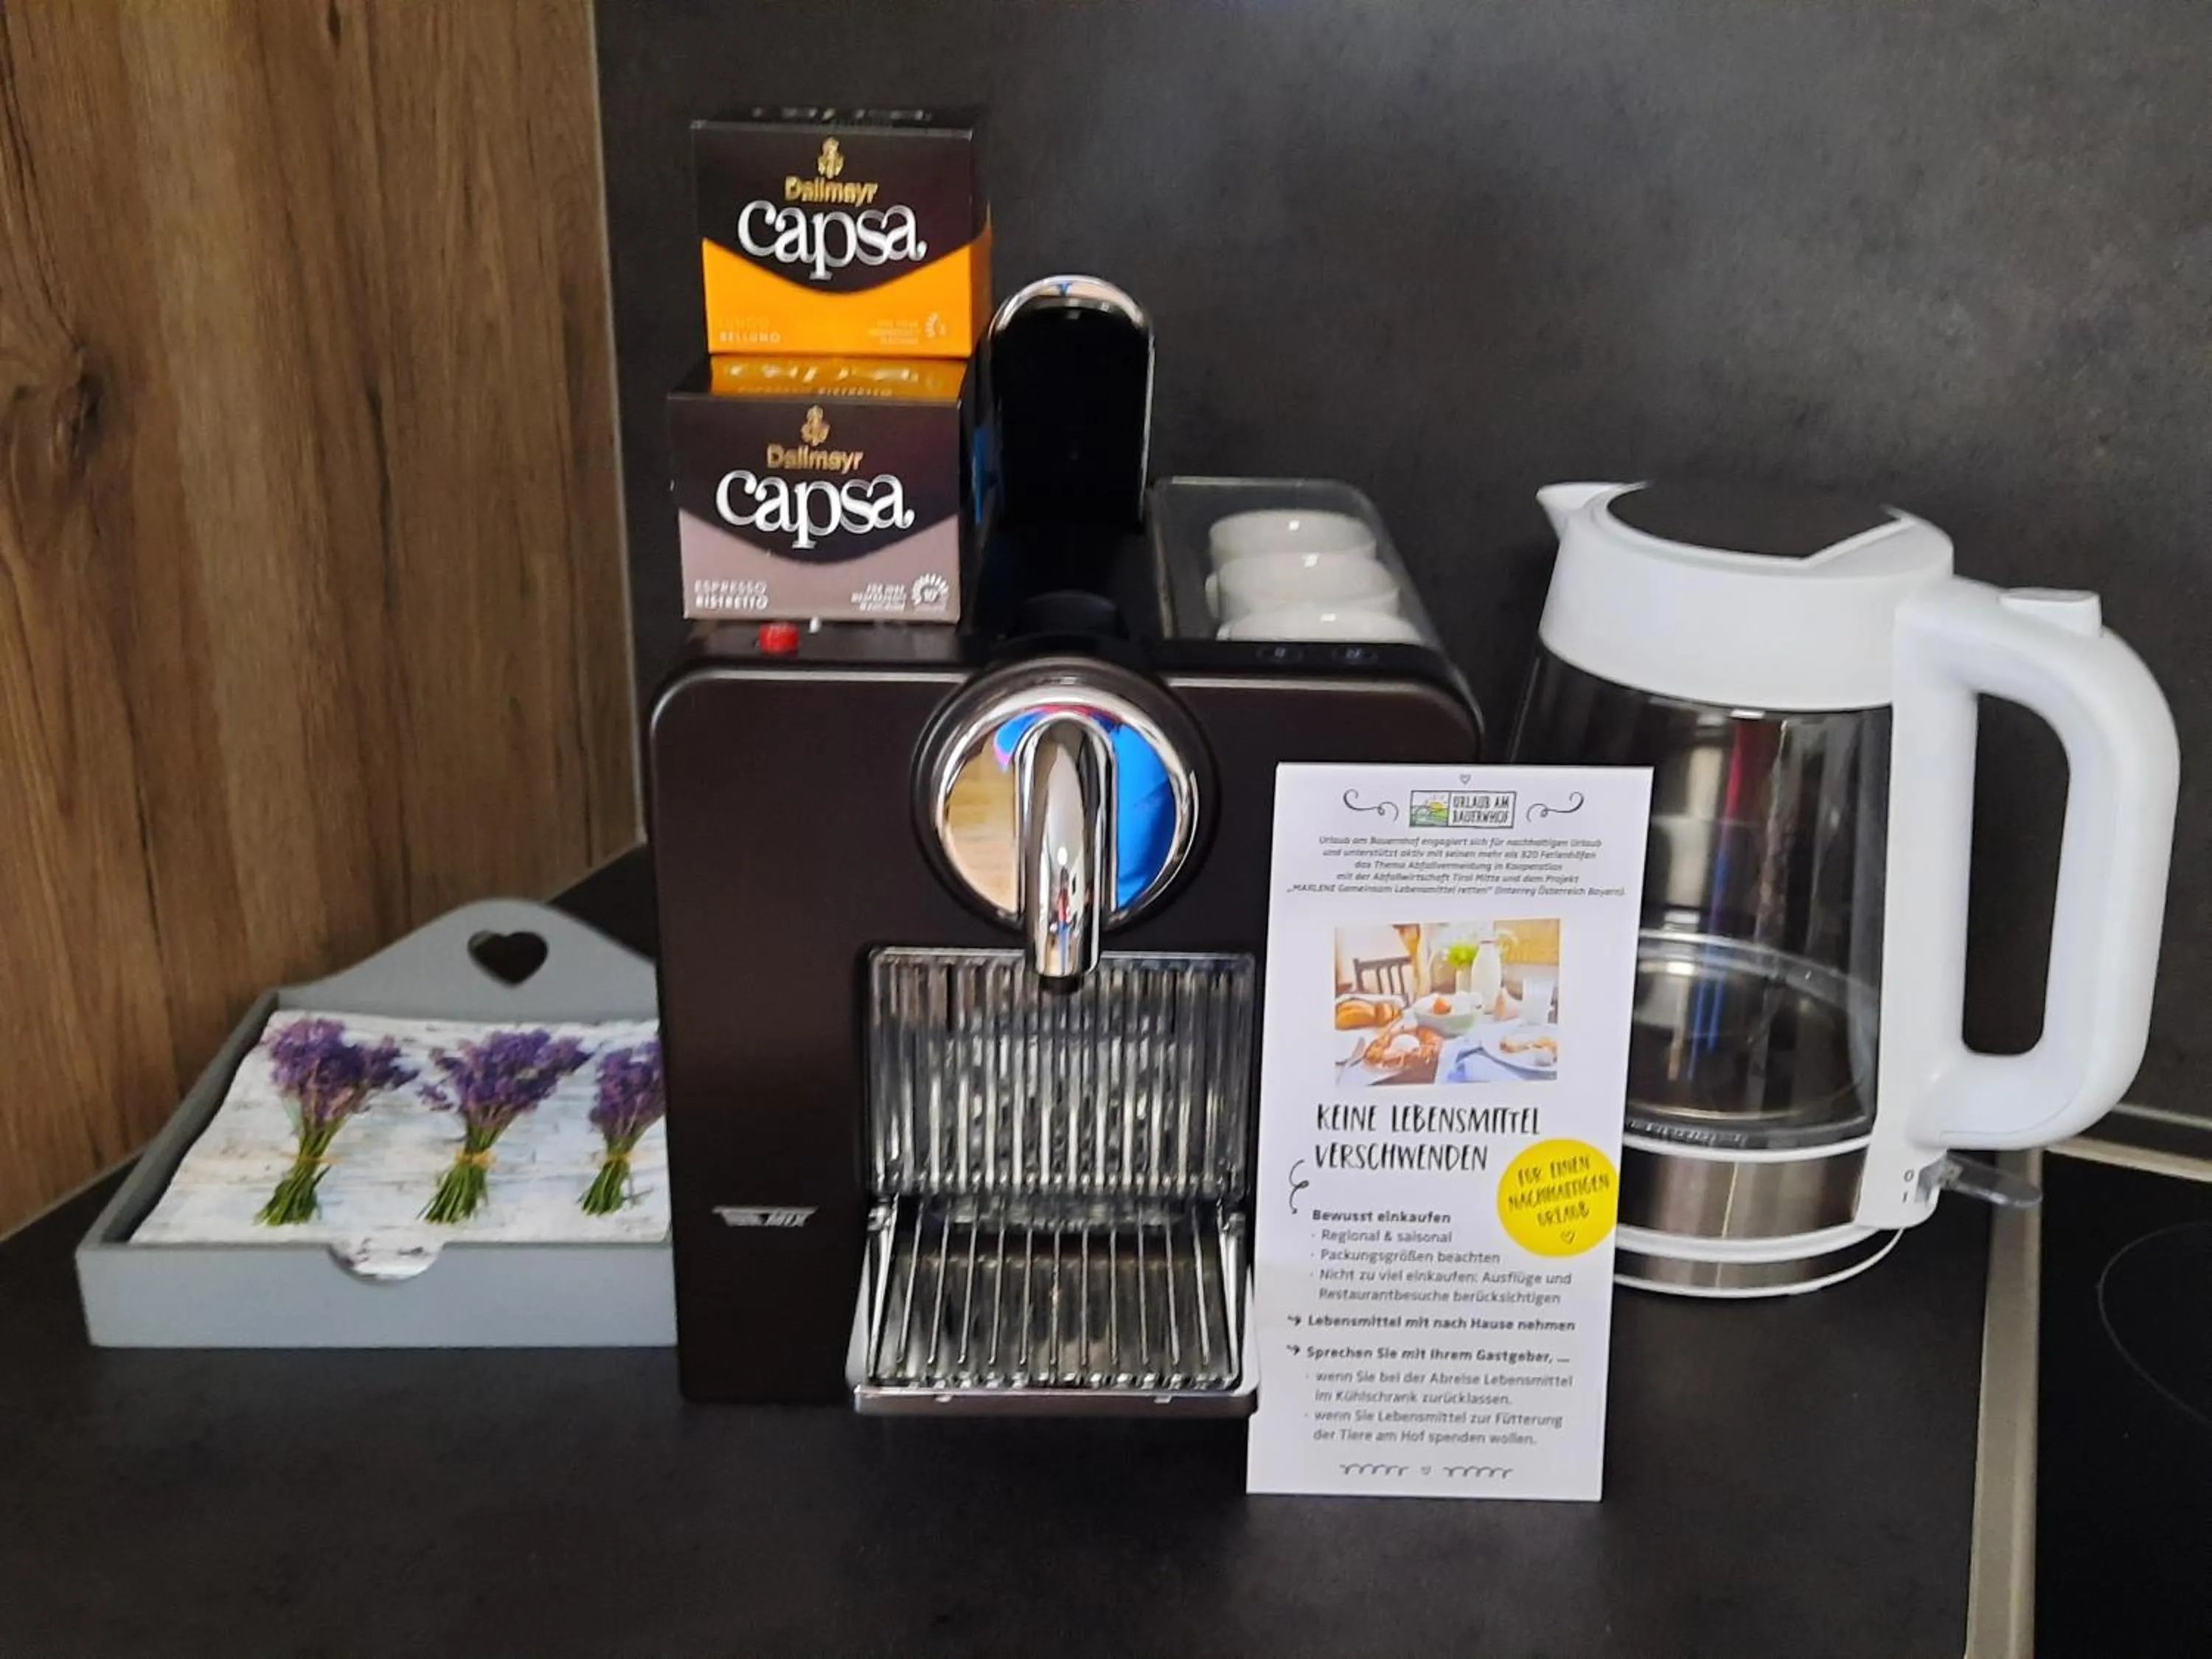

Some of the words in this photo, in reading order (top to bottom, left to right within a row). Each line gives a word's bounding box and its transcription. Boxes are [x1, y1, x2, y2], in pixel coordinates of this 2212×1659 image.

[785, 176, 878, 206] Dallmayr
[737, 200, 928, 279] capsa
[767, 444, 864, 474] Dallmayr
[717, 470, 914, 549] capsa
[695, 580, 767, 594] ESPRESSO
[695, 594, 768, 610] RISTRETTO
[1453, 796, 1489, 808] URLAUB
[1494, 796, 1509, 809] AM
[1371, 837, 1420, 846] Bauernhof
[1422, 838, 1467, 848] engagiert
[1489, 838, 1503, 848] für
[1506, 840, 1568, 849] nachhaltigen
[1571, 840, 1602, 848] Urlaub
[1540, 852, 1596, 860] Ferienhöfen
[1408, 862, 1491, 872] Abfallvermeidung
[1506, 863, 1563, 872] Kooperation
[1373, 874, 1449, 883] Abfallwirtschaft
[1545, 876, 1579, 885] Projekt
[1338, 885, 1392, 893] Gemeinsam
[1394, 886, 1456, 894] Lebensmittel
[1317, 1104, 1377, 1131] KEINE
[1391, 1105, 1540, 1134] LEBENSMITTEL
[1315, 1143, 1488, 1171] VERSCHWENDEN
[1312, 1210, 1372, 1222] Bewusst
[1377, 1211, 1451, 1224] einkaufen
[1321, 1230, 1380, 1243] Regional
[1385, 1231, 1393, 1242] &
[1397, 1231, 1453, 1242] saisonal
[1320, 1250, 1433, 1267] Packungsgrößen
[1438, 1253, 1500, 1265] beachten
[1320, 1269, 1354, 1281] Nicht
[1360, 1272, 1374, 1281] zu
[1379, 1270, 1403, 1281] viel
[1483, 1272, 1543, 1287] Ausflüge
[1546, 1273, 1571, 1284] und
[1319, 1290, 1449, 1303] Restaurantbesuche
[1453, 1291, 1560, 1308] berücksichtigen
[1308, 1315, 1401, 1328] Lebensmittel
[1405, 1317, 1429, 1329] mit
[1433, 1318, 1467, 1329] nach
[1471, 1318, 1513, 1330] Hause
[1518, 1319, 1576, 1332] nehmen
[1307, 1346, 1372, 1362] Sprechen
[1377, 1348, 1397, 1360] Sie
[1402, 1348, 1426, 1360] mit
[1430, 1349, 1472, 1361] Ihrem
[1315, 1374, 1352, 1383] wenn
[1356, 1373, 1375, 1383] Sie
[1380, 1374, 1400, 1384] bei
[1403, 1374, 1426, 1385] der
[1430, 1374, 1480, 1385] Abreise
[1484, 1375, 1573, 1388] Lebensmittel
[1315, 1390, 1332, 1400] im
[1336, 1391, 1416, 1402] Kühlschrank
[1314, 1412, 1352, 1422] wenn
[1355, 1411, 1374, 1421] Sie
[1378, 1412, 1466, 1424] Lebensmittel
[1495, 1413, 1562, 1427] Fütterung
[1313, 1429, 1335, 1441] der
[1339, 1430, 1372, 1441] Tiere
[1376, 1432, 1397, 1441] am
[1401, 1430, 1425, 1442] Hof
[1429, 1431, 1485, 1445] spenden
